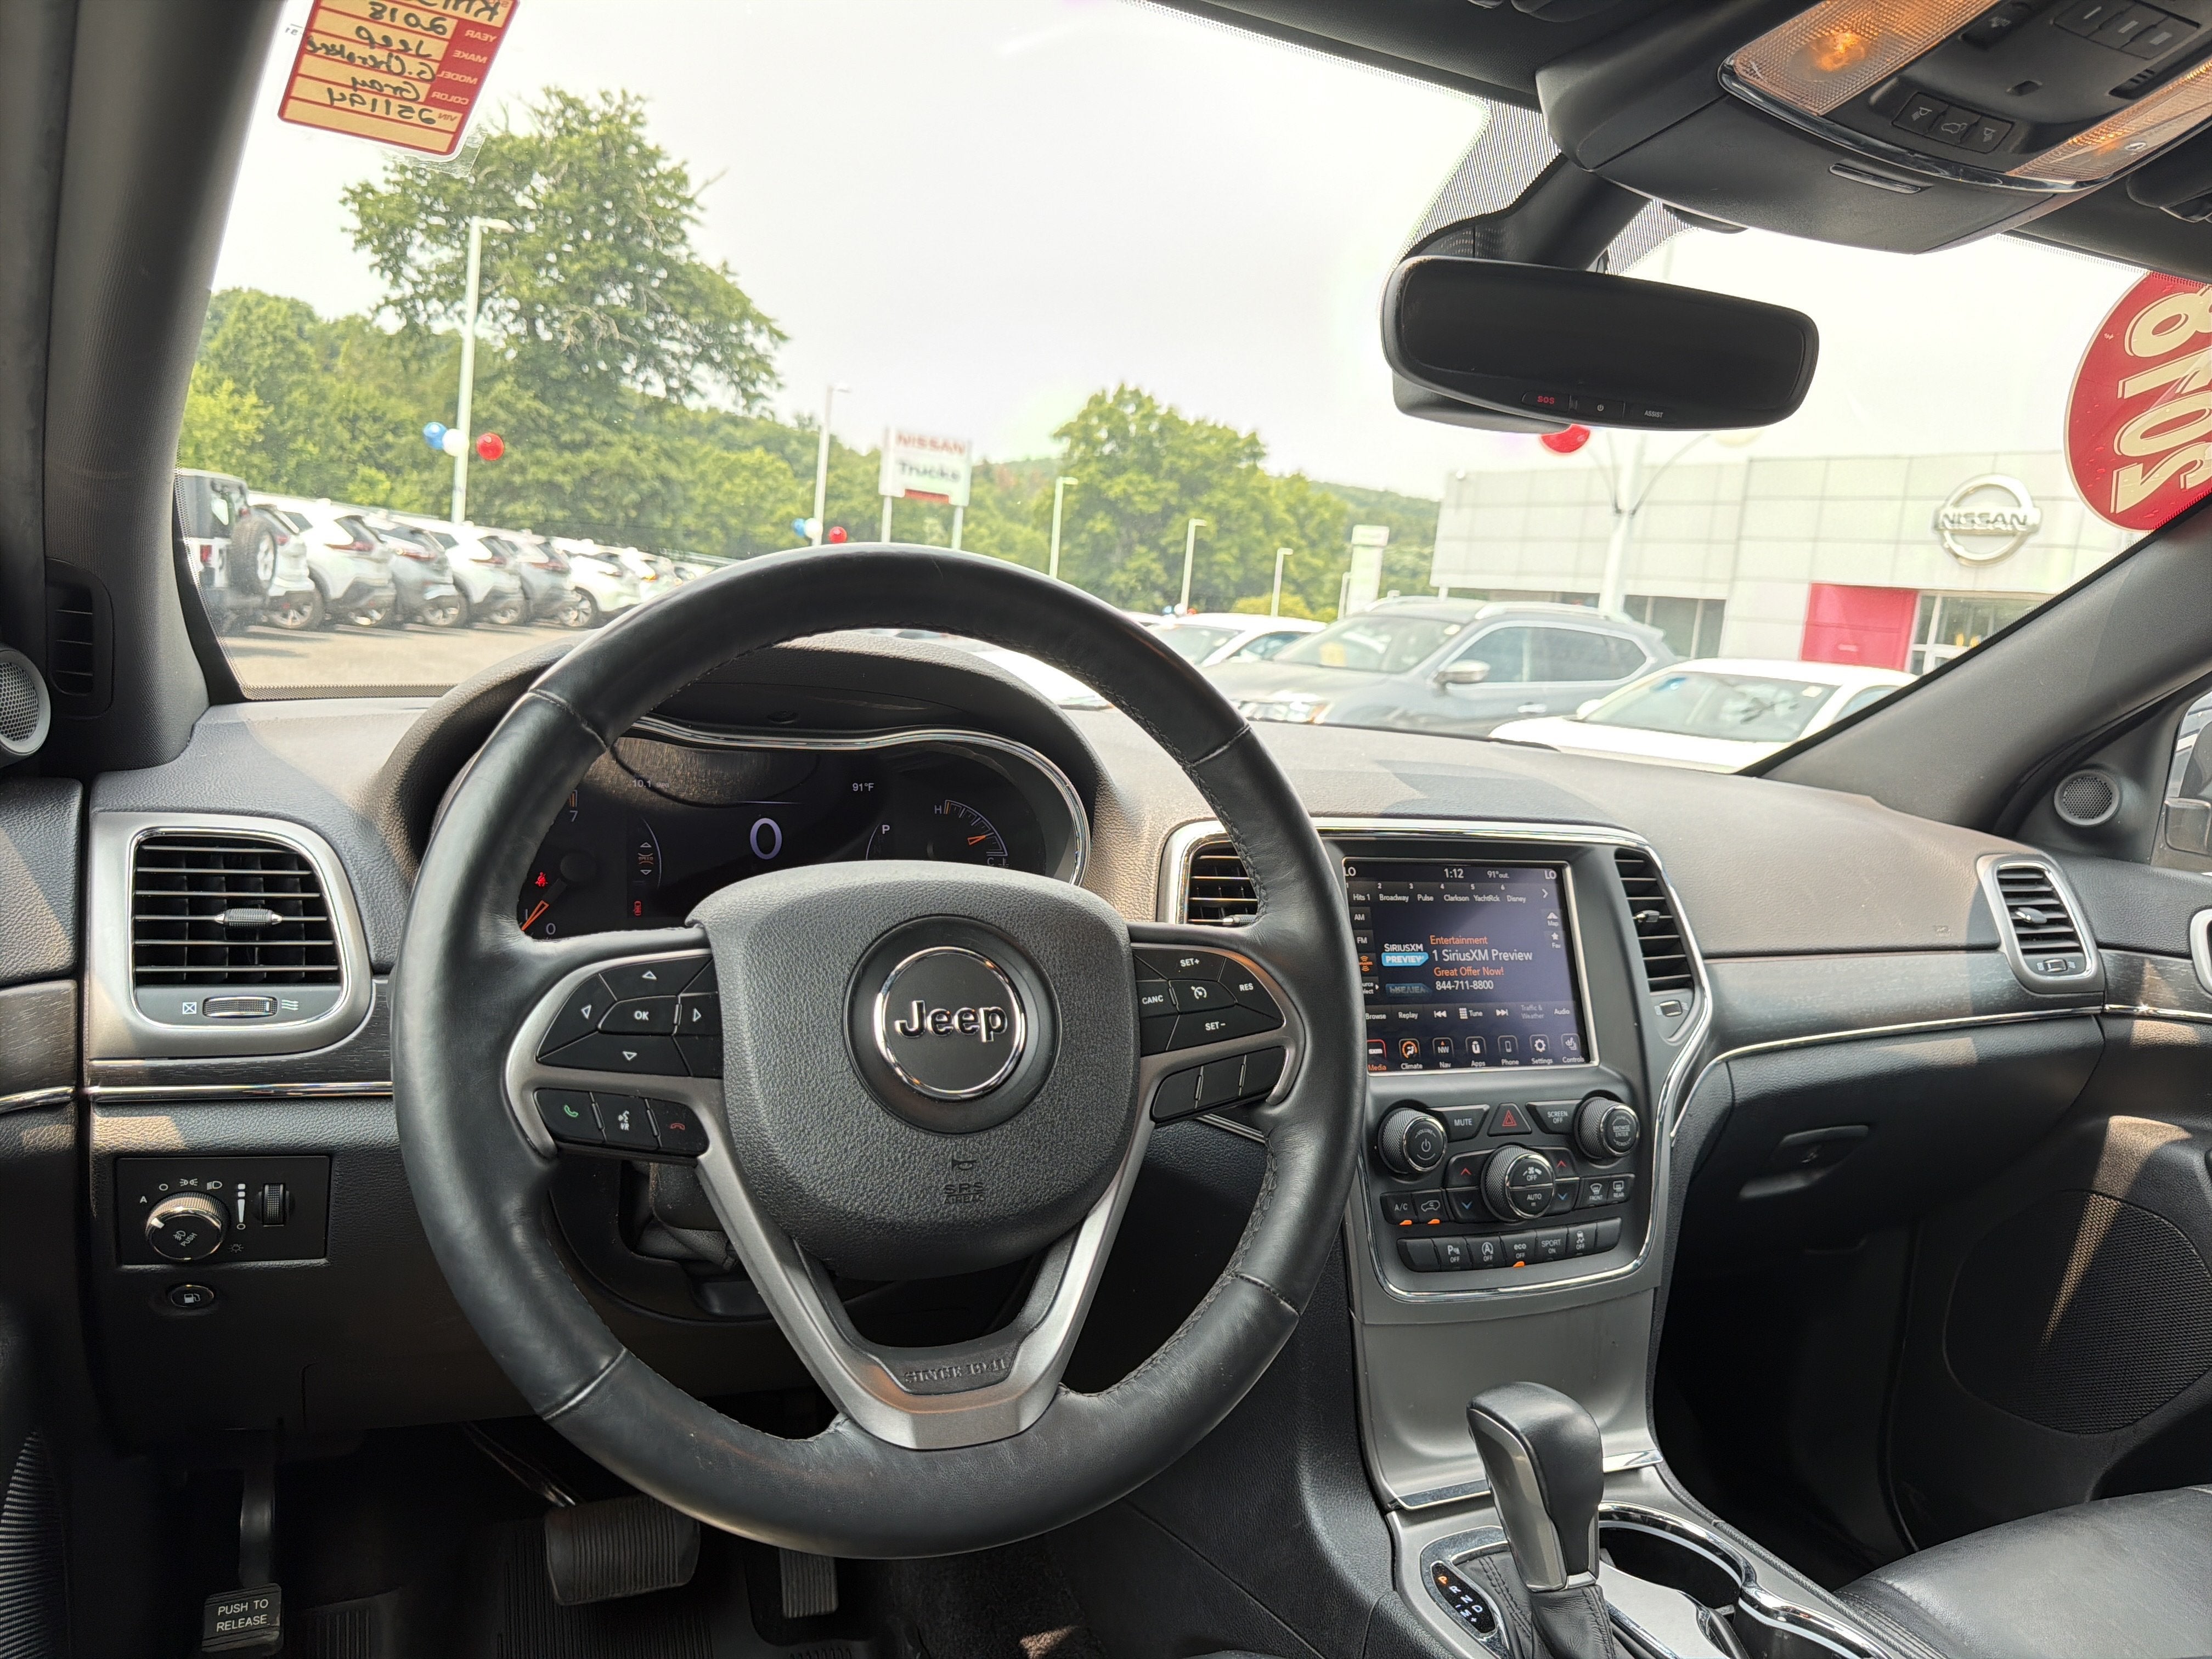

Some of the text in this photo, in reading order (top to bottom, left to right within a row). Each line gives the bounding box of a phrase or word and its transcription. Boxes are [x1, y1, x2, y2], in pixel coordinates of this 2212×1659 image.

[1537, 396, 1555, 404] SOS
[1644, 410, 1663, 418] ASSIST
[896, 433, 966, 454] NISSAN
[1943, 512, 2028, 527] NISSAN
[632, 779, 651, 788] 10.1
[853, 783, 874, 792] 91°F
[934, 805, 942, 814] H
[569, 810, 578, 822] 7
[882, 825, 890, 834] P
[750, 817, 782, 860] 0
[1444, 868, 1464, 878] 1:12
[1544, 870, 1556, 879] LO
[1379, 894, 1409, 902] Broadway
[546, 923, 556, 935] 0
[1430, 935, 1487, 945] Entertainment
[1384, 943, 1423, 952] SIRIUSXM
[1385, 955, 1424, 963] PREVIEW
[1432, 949, 1532, 961] 1 SiriusXM Preview
[1434, 967, 1504, 977] Great Offer Now!
[1239, 983, 1254, 991] RES
[1436, 980, 1493, 990] 844-711-8800
[1142, 995, 1164, 1005] CANC
[634, 1010, 648, 1021] OK
[895, 1000, 1008, 1043] Jeep
[620, 1122, 629, 1131] VR
[944, 1182, 984, 1194] SRS
[140, 1195, 148, 1204] A
[180, 1232, 198, 1247] PUSH
[1541, 1239, 1561, 1248] SPORT
[904, 1365, 962, 1383] SINCE
[1438, 1576, 1447, 1585] P
[1448, 1585, 1462, 1594] R
[1460, 1594, 1473, 1604] N
[218, 1599, 269, 1616] PUSH TO
[1471, 1605, 1483, 1613] D
[216, 1614, 268, 1632] RELEASE
